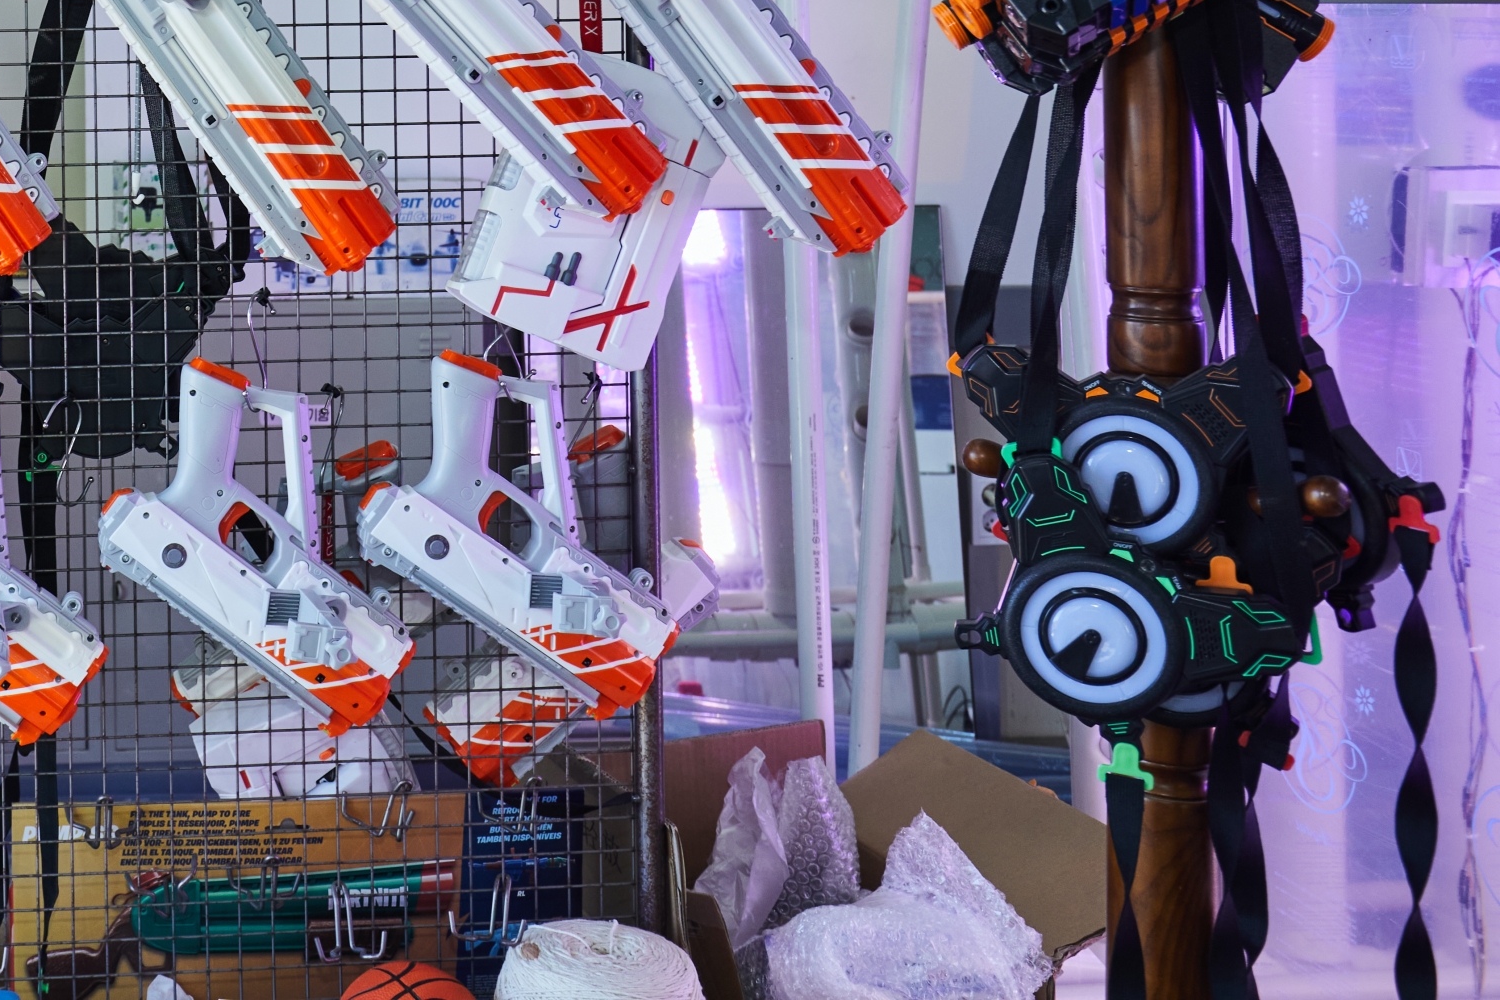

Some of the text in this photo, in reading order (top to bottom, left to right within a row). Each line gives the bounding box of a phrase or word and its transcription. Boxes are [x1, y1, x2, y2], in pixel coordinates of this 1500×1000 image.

[401, 197, 424, 209] BIT
[541, 795, 558, 803] FOR
[148, 810, 165, 818] THE
[192, 810, 217, 818] PUMP
[232, 809, 251, 817] FRE
[128, 819, 165, 828] RMPLIS
[22, 824, 84, 842] PMP
[279, 837, 290, 845] ZU
[149, 848, 159, 856] EL
[155, 858, 162, 866] O
